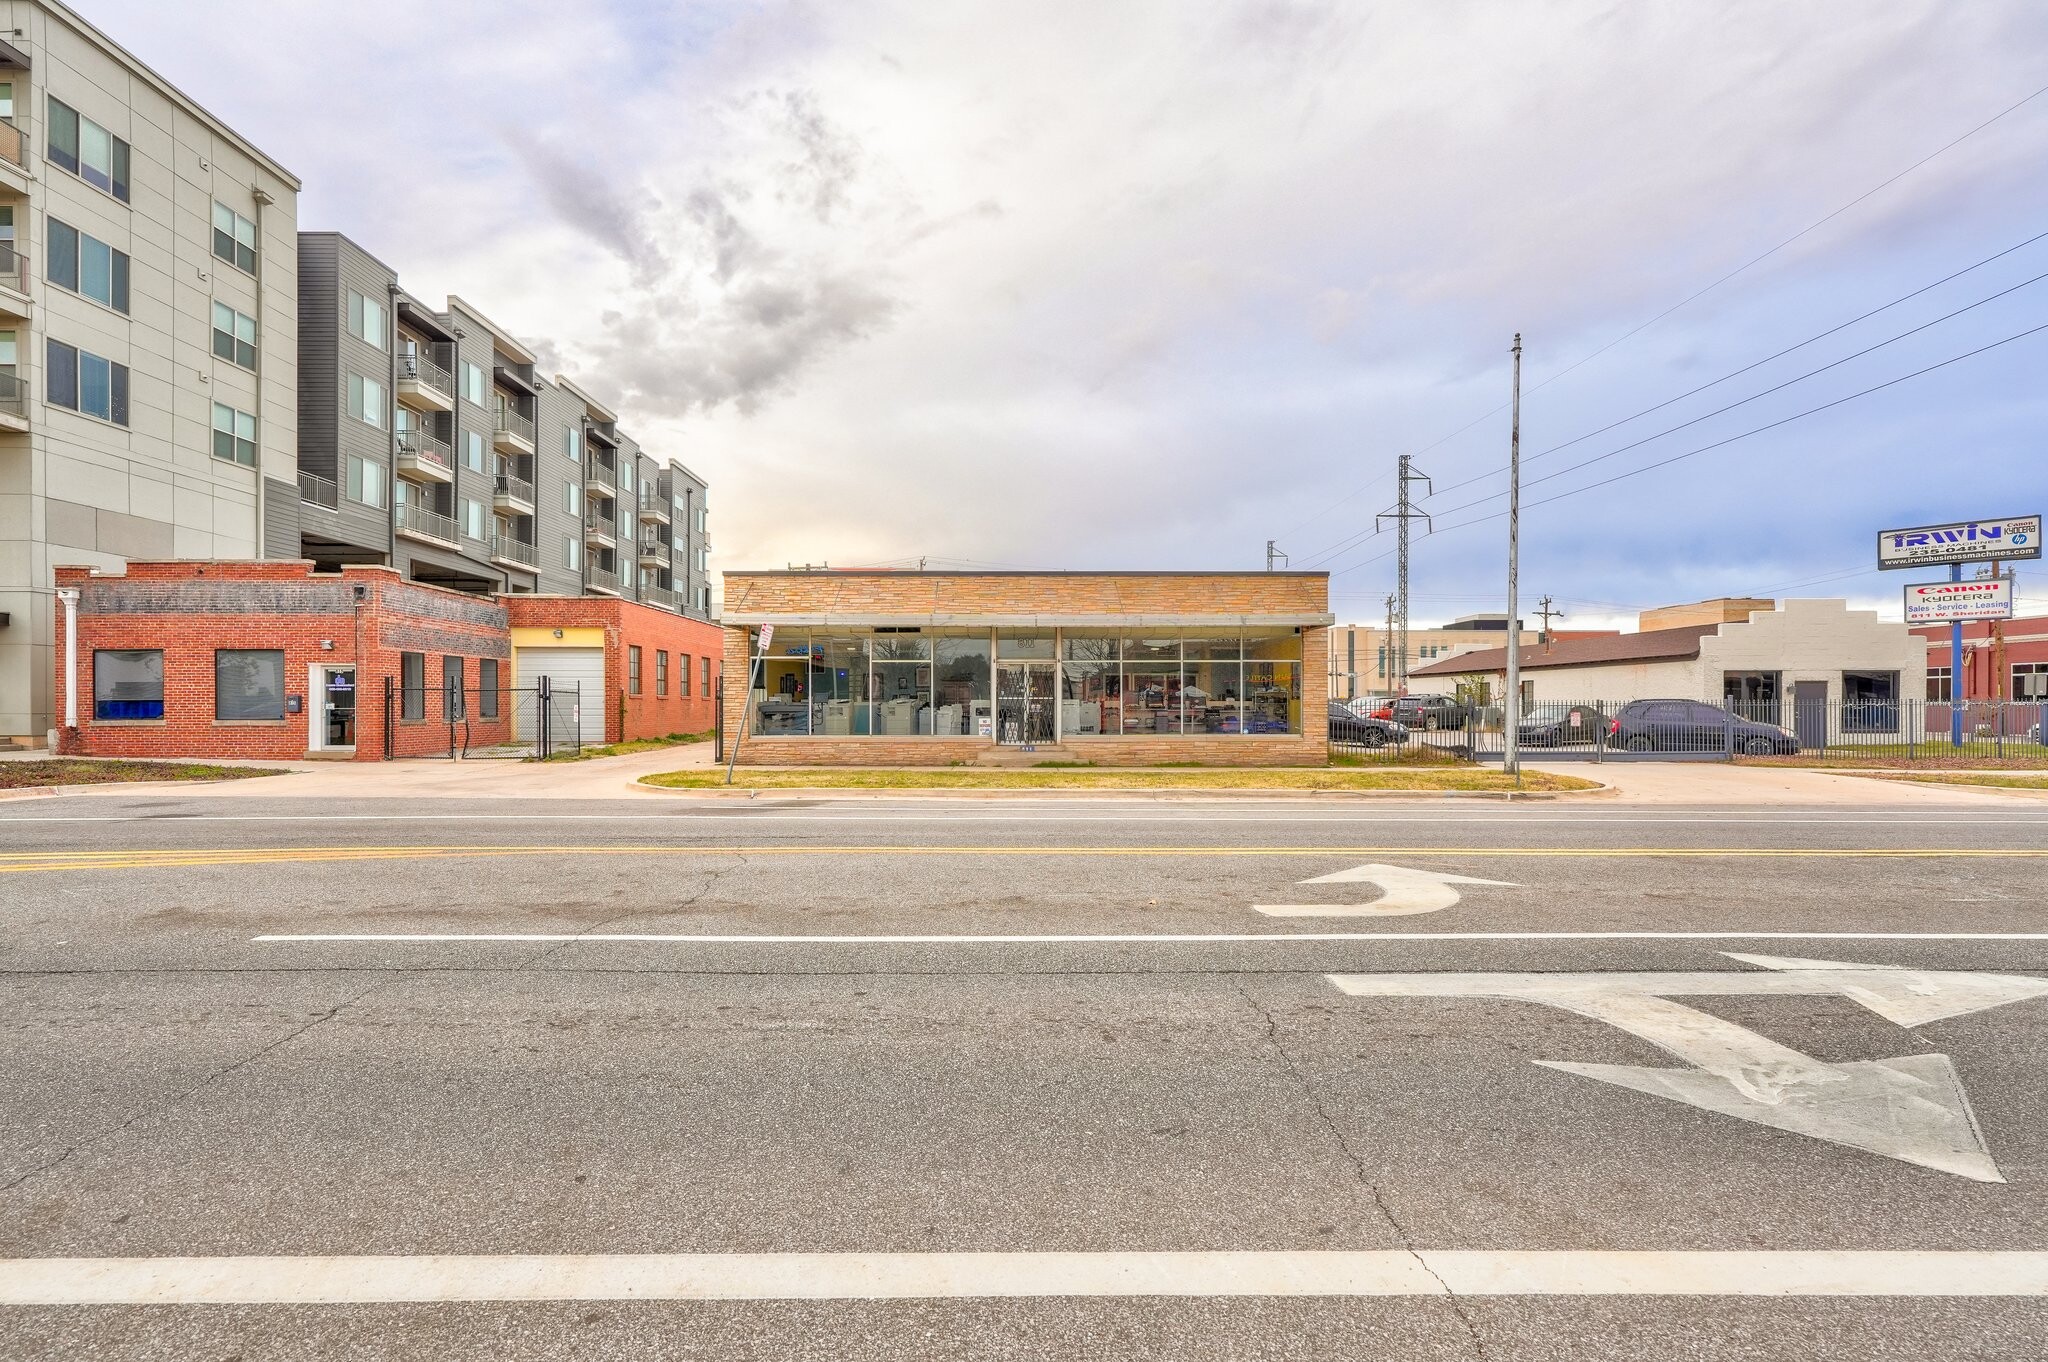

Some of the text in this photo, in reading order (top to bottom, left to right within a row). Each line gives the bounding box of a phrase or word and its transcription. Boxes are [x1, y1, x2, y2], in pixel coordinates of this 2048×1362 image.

[2004, 525, 2036, 535] KYOCERA
[2013, 534, 2026, 545] hp
[1894, 539, 2001, 552] BUSINESS MACHINES
[1909, 545, 1987, 556] 235-0481
[1884, 548, 2035, 565] www.irwinbusinessmachines.com
[1917, 584, 1999, 595] Canon
[1922, 593, 1993, 603] KYOCERA
[1937, 603, 1968, 611] Service
[1975, 601, 2009, 609] Leasing
[1018, 638, 1035, 648] 811
